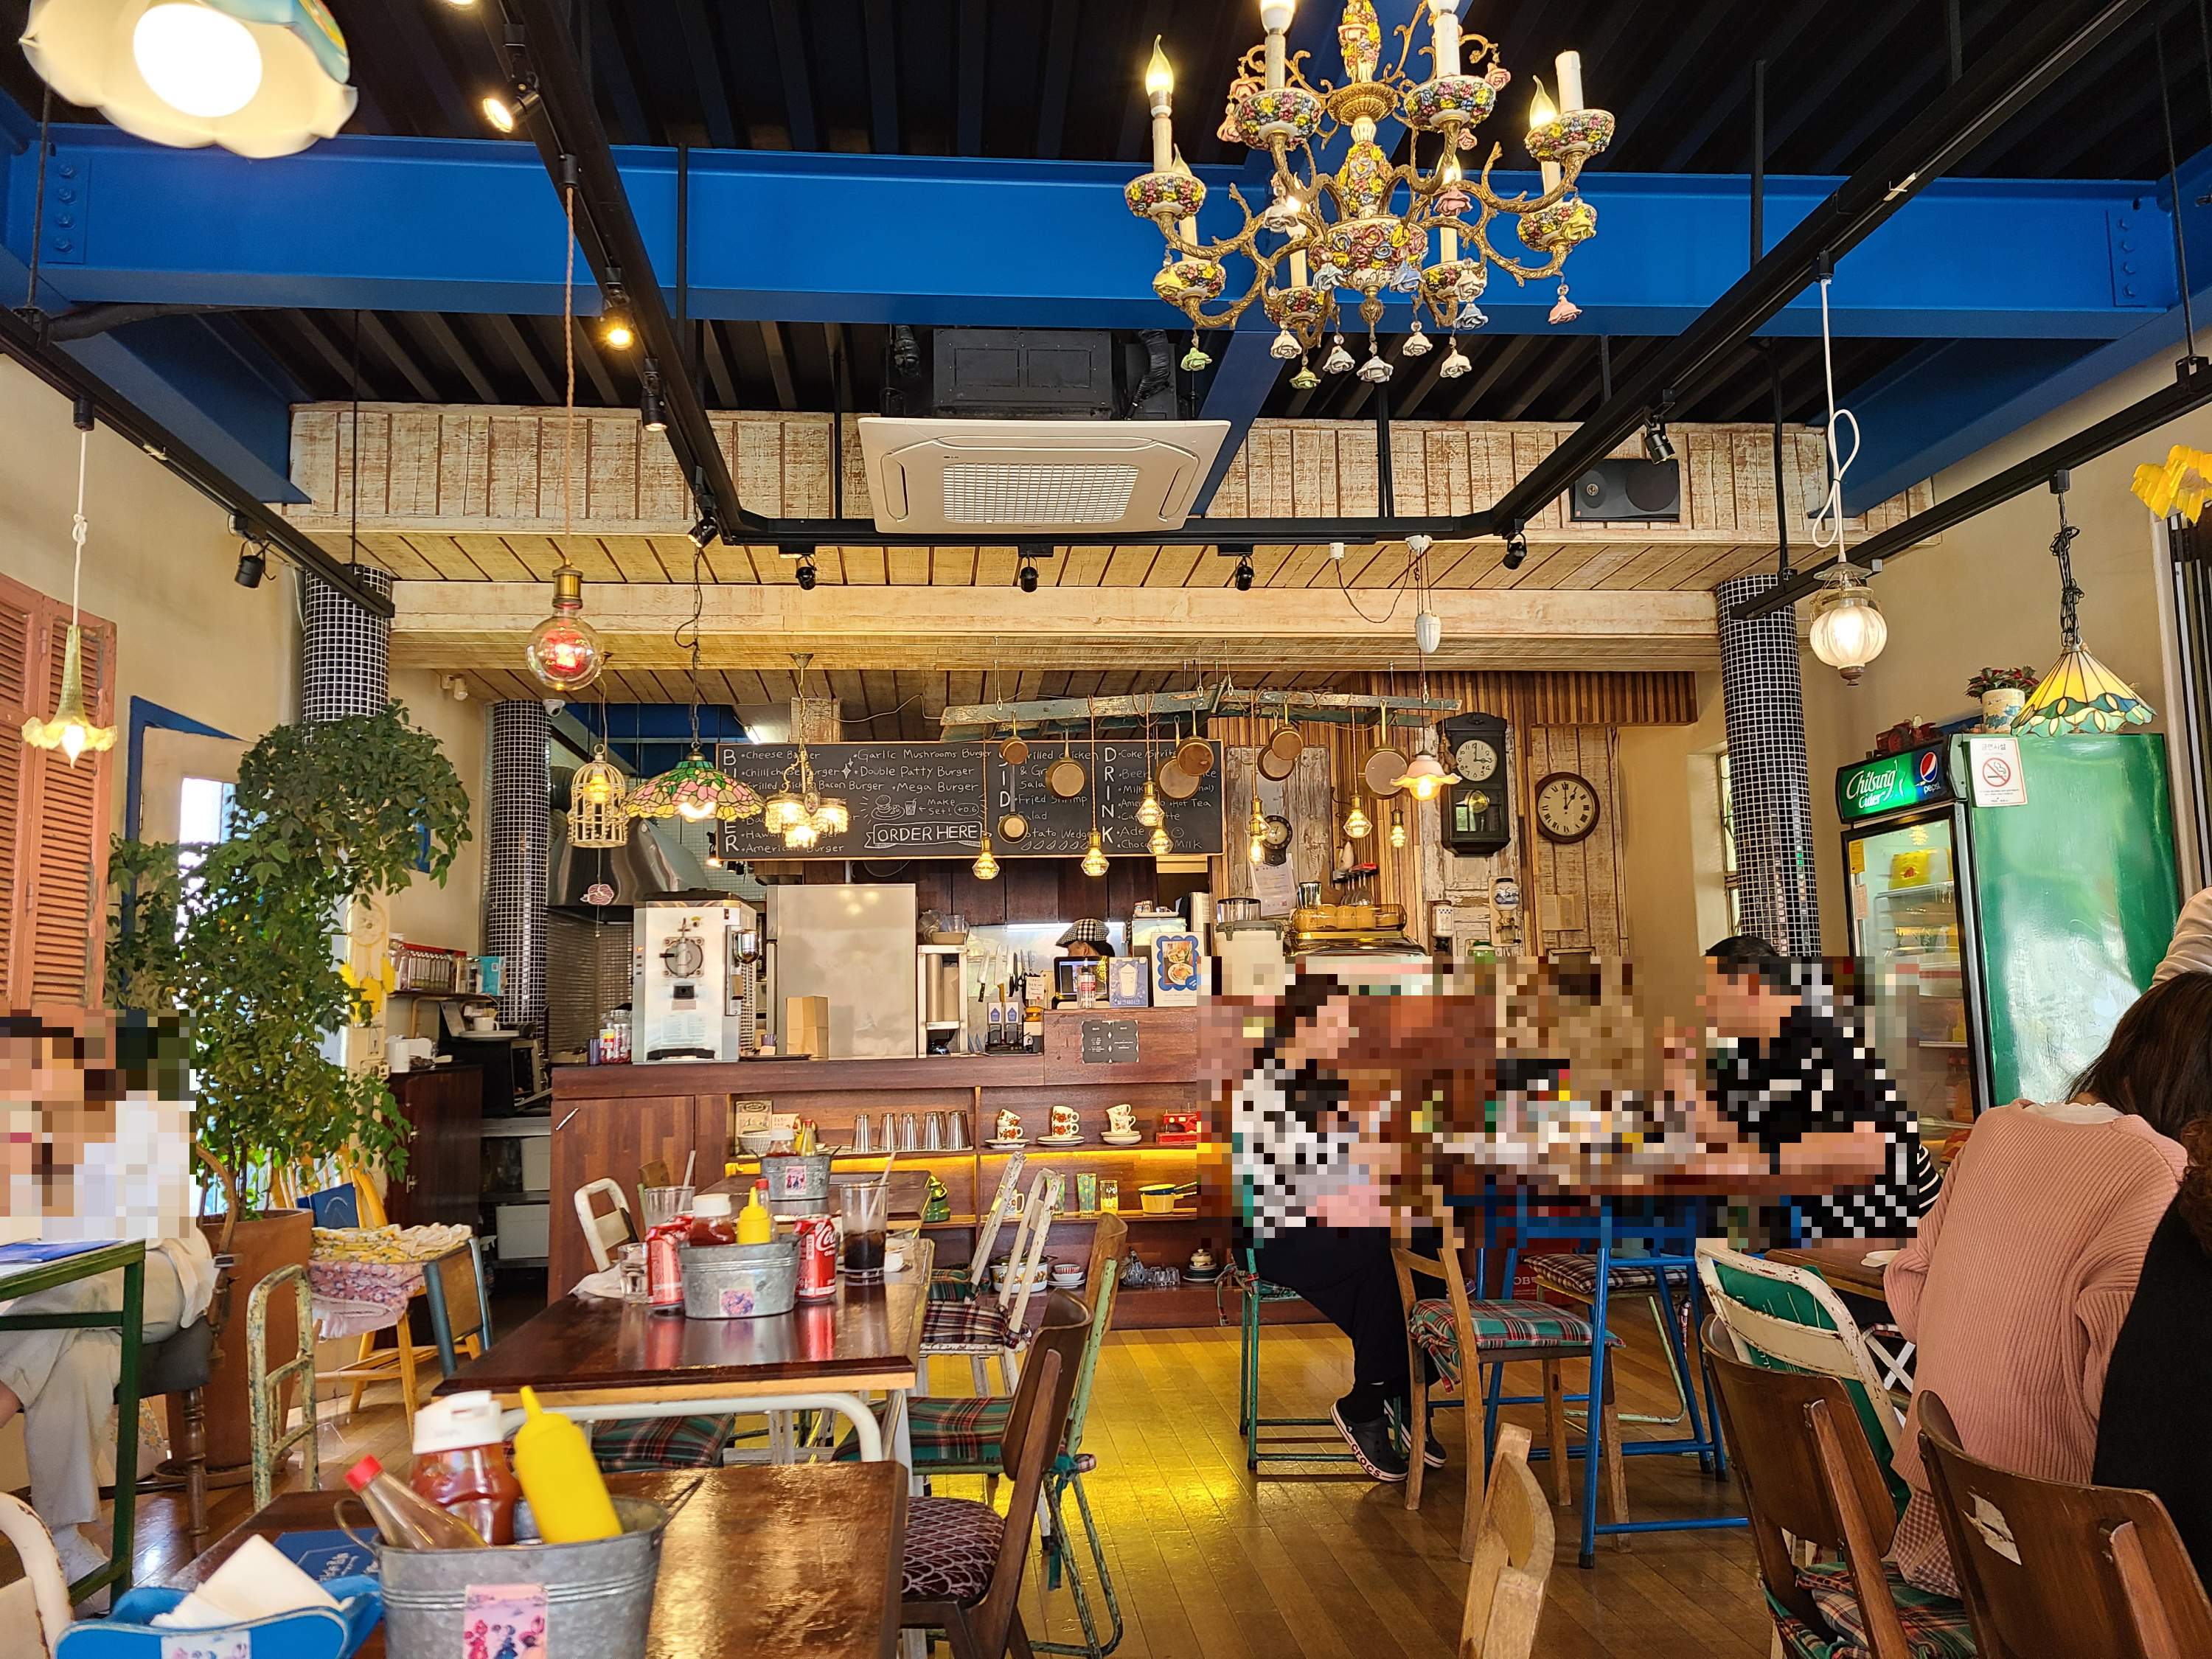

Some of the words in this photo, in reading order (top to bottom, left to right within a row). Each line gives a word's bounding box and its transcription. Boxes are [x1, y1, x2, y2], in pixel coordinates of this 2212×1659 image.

[746, 751, 783, 759] Cheese
[787, 750, 821, 760] Buer
[858, 749, 897, 762] Garlic
[903, 749, 957, 759] Mushrooms
[961, 748, 992, 759] Burger
[1024, 750, 1054, 764] rilled
[1058, 751, 1099, 761] cicken
[1121, 749, 1142, 759] Coke
[860, 765, 896, 776] Double
[900, 766, 933, 779] Patty
[937, 765, 975, 776] Burger
[818, 780, 846, 790] Bacon
[849, 781, 885, 792] Burger
[897, 782, 932, 794] Mega
[937, 782, 979, 793] Burger
[1019, 780, 1046, 789] Sala
[1846, 769, 1898, 801] Chilsung
[1923, 782, 1942, 795] pepsi
[1018, 793, 1046, 804] Fried
[1191, 799, 1211, 807] Tea
[877, 827, 933, 842] ORDER
[936, 824, 978, 840] HERE
[1026, 827, 1057, 838] otato
[1119, 826, 1144, 837] Ade
